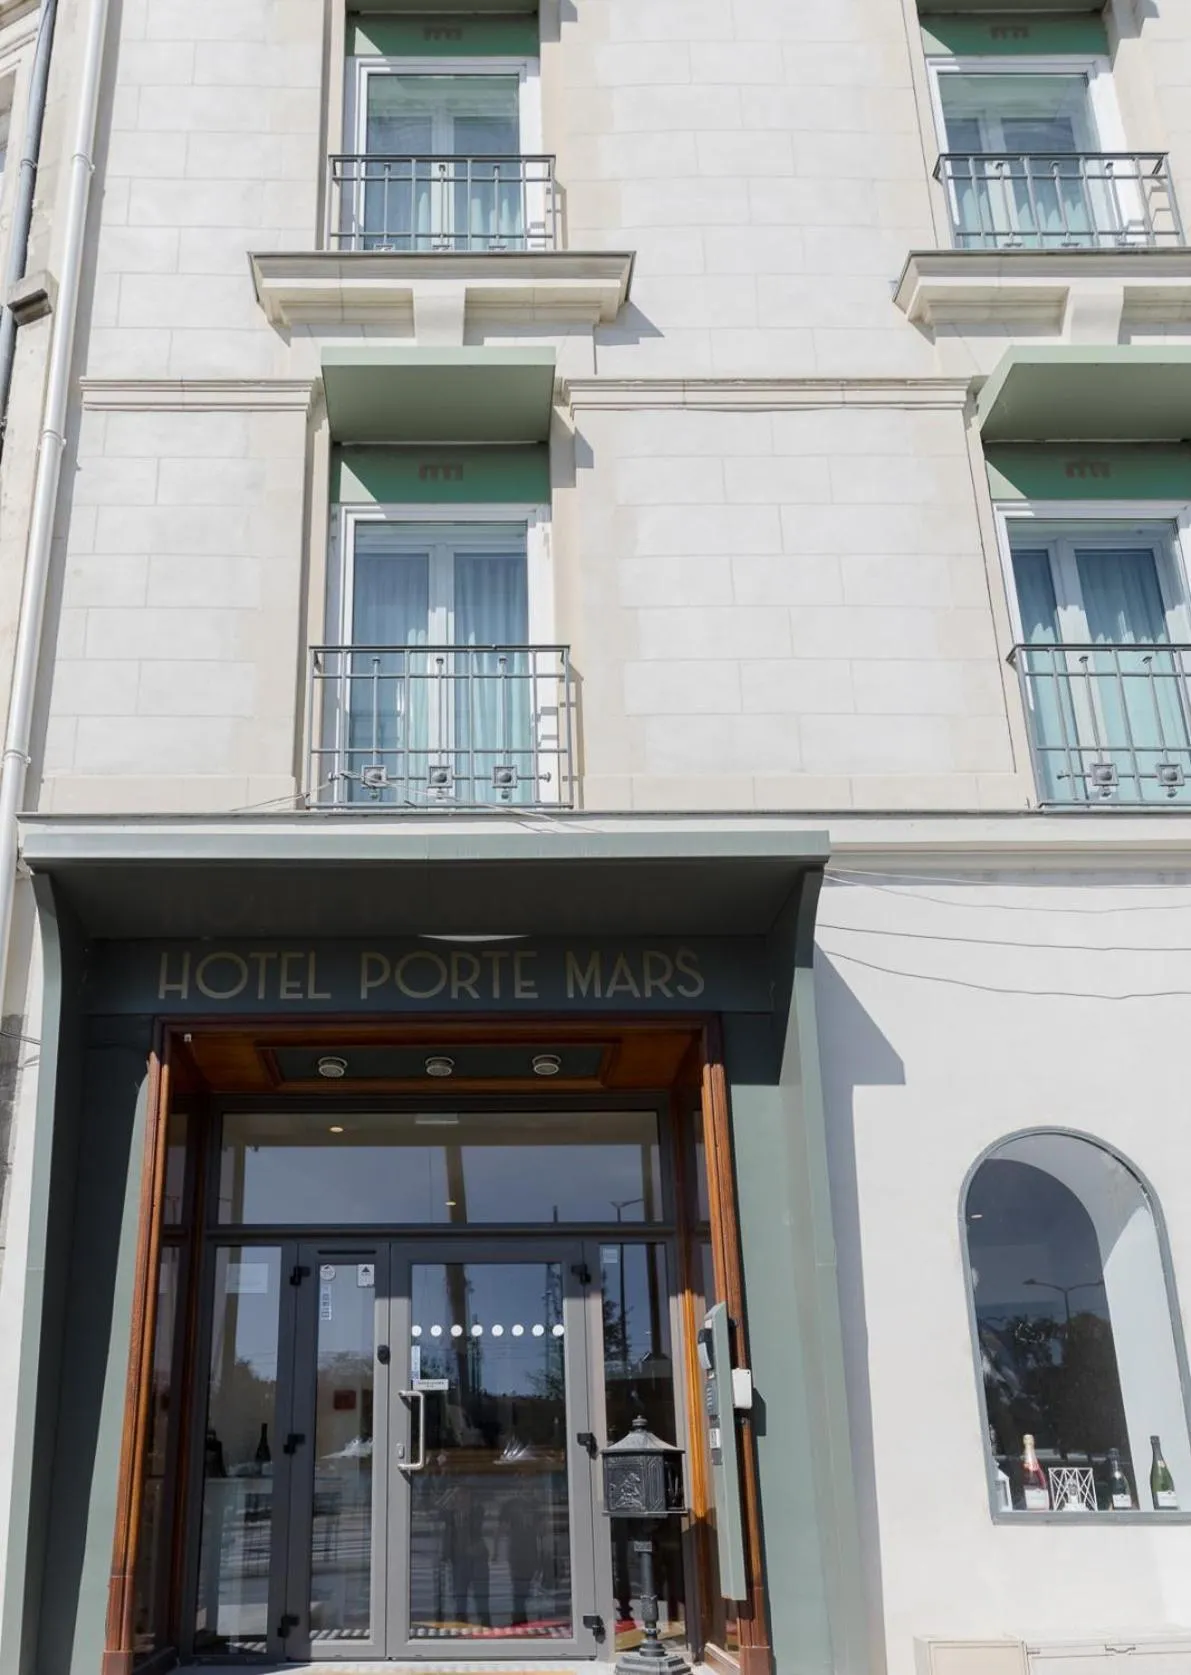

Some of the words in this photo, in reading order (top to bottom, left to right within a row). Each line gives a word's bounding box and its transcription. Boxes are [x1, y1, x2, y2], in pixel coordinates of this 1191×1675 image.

[157, 950, 332, 1000] HOTEL
[359, 950, 539, 1000] PORTE
[565, 947, 706, 999] MARS
